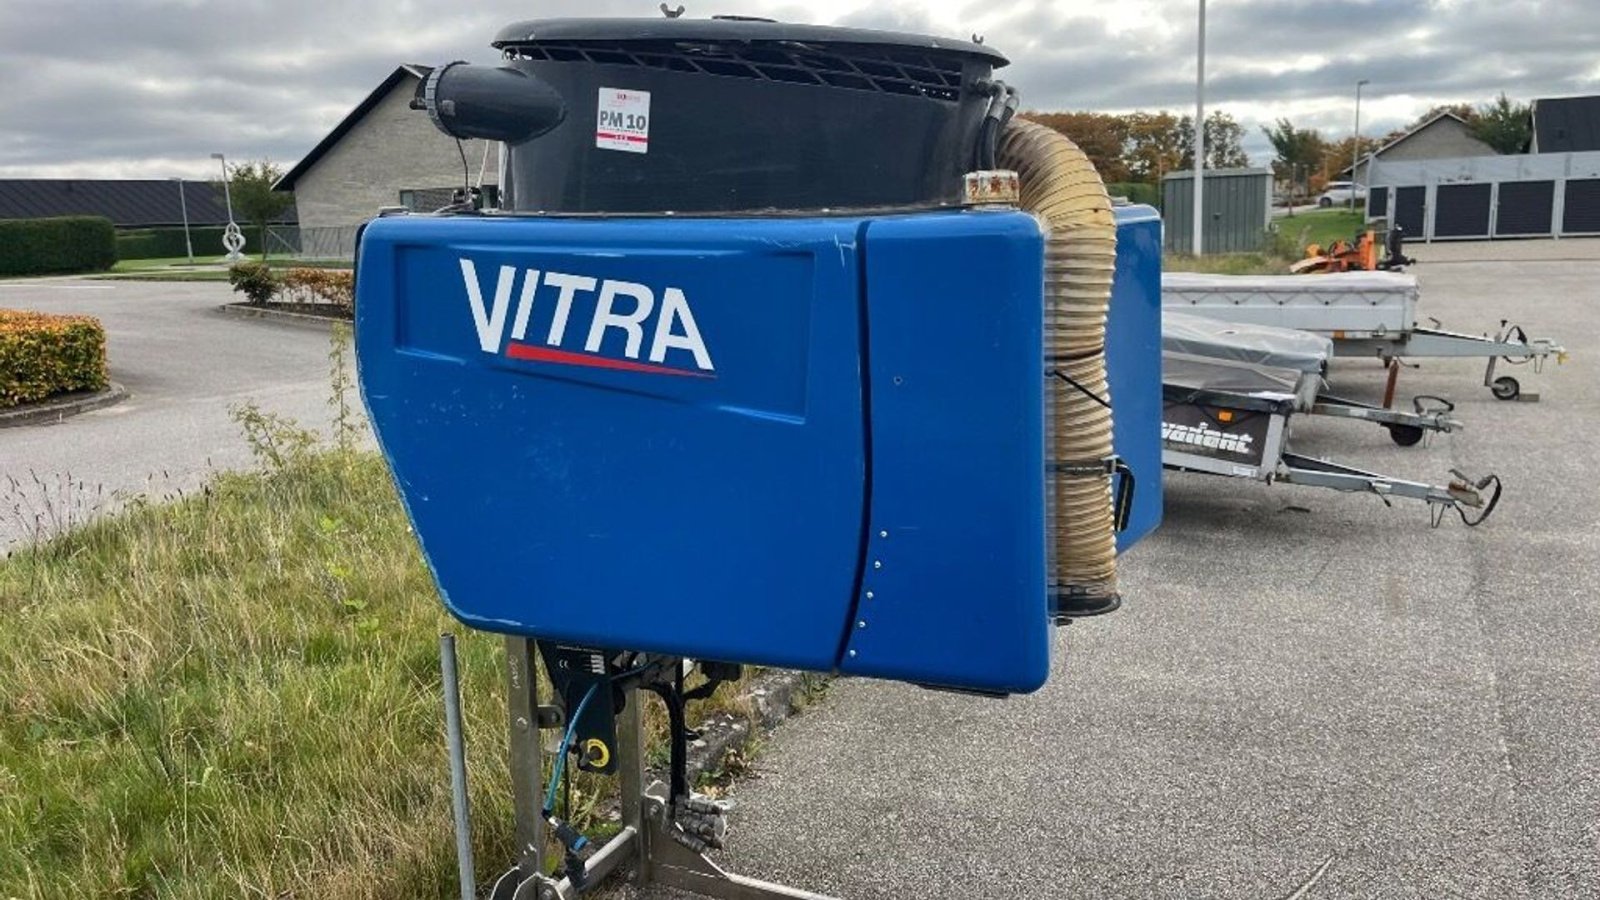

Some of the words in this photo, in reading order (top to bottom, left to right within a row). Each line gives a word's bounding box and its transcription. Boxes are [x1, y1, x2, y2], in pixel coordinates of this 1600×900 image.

[599, 110, 623, 128] PM
[626, 113, 647, 131] 10
[459, 258, 715, 371] VITRA
